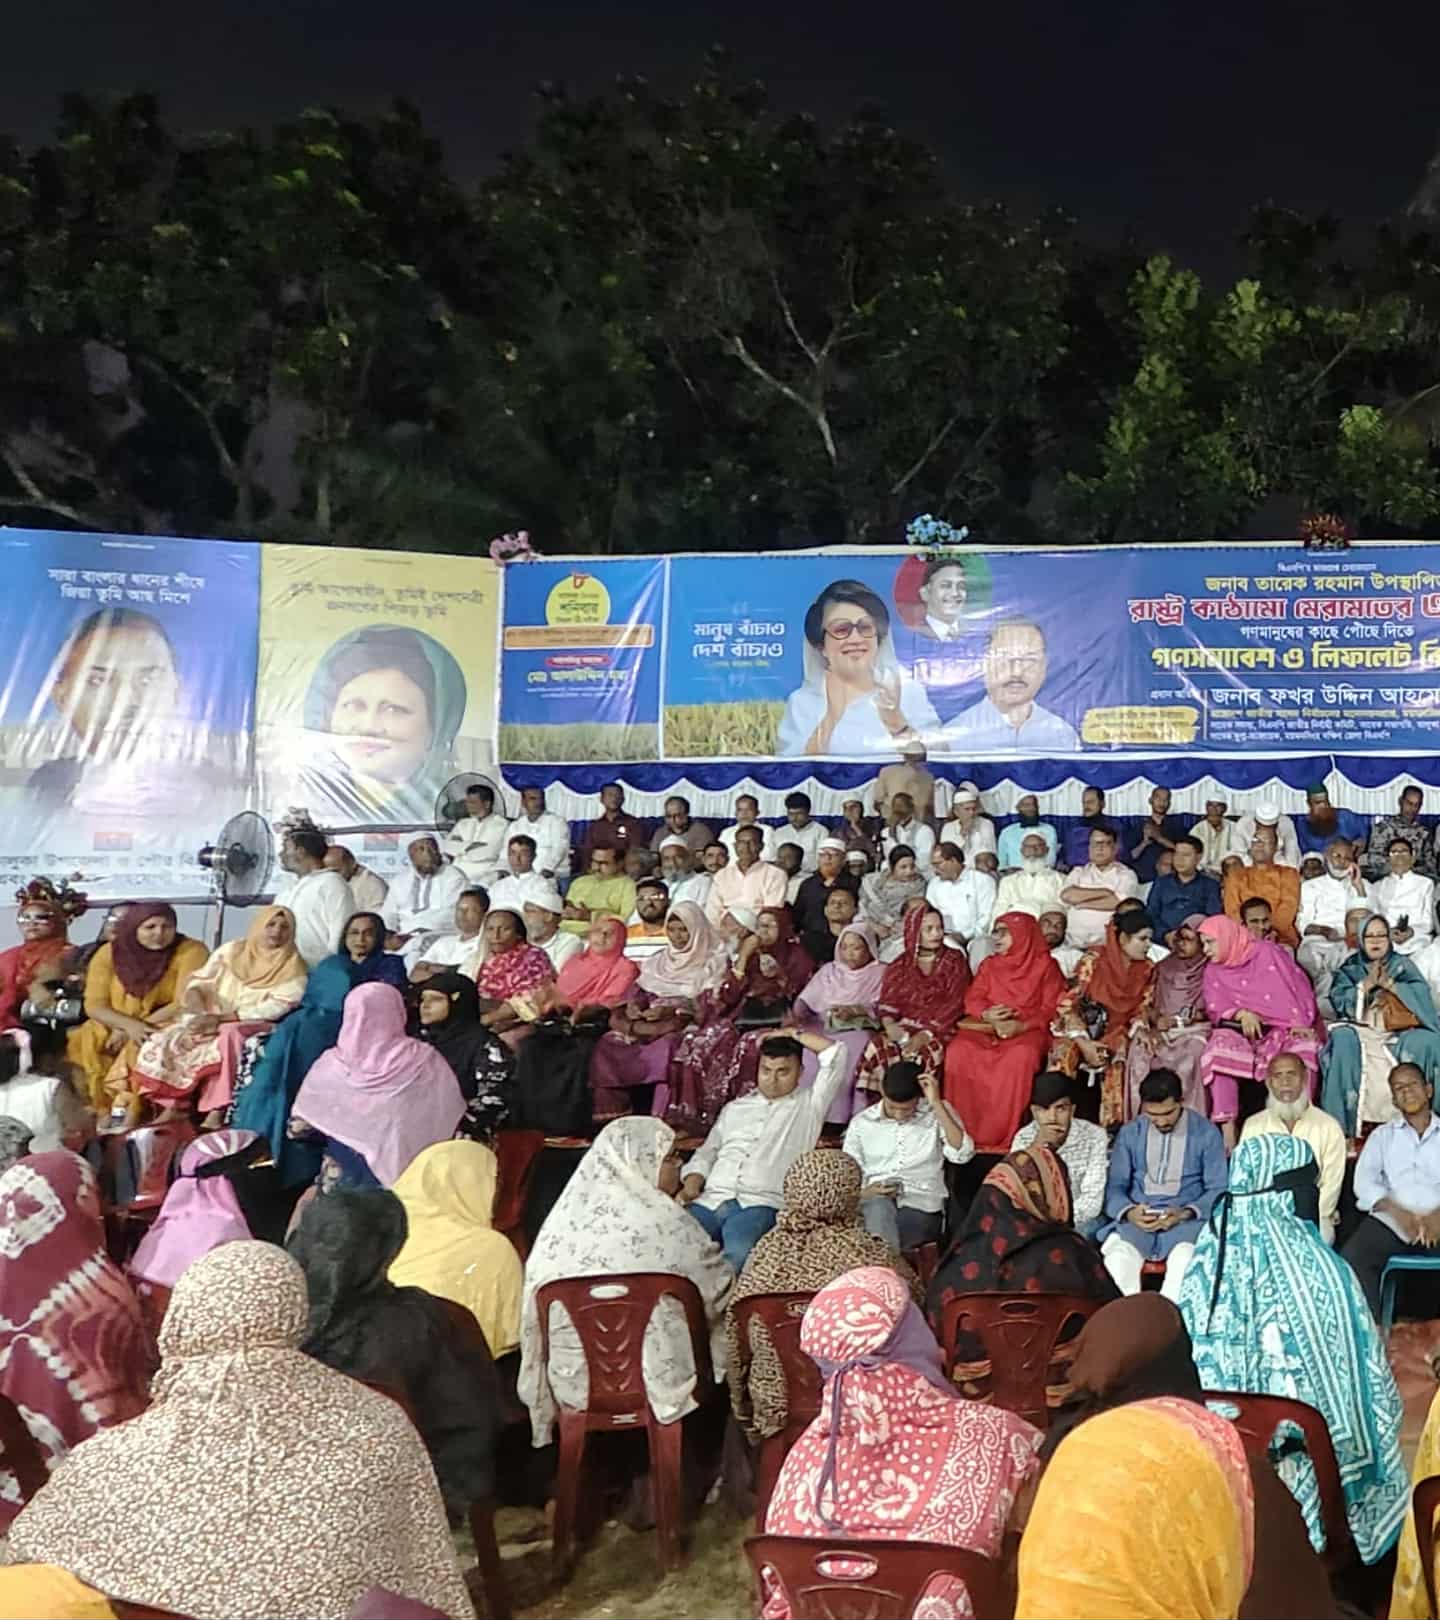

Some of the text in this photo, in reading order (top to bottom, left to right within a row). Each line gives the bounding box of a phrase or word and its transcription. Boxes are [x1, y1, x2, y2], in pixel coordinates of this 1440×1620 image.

[81, 570, 126, 585] বাংলার
[1204, 576, 1249, 592] জনাব
[1255, 576, 1308, 592] তারেক
[1312, 575, 1364, 592] রহমান
[96, 585, 122, 604] তুমি
[1127, 593, 1186, 626] রাষ্ট্র
[1190, 591, 1288, 621] কাঠামো
[1293, 596, 1414, 621] মেরামতের
[693, 619, 785, 641] মানুষ বাঁচাও
[1240, 625, 1304, 641] গণমানুষের
[1308, 624, 1339, 640] কাছে
[1383, 622, 1415, 639] দিতে
[693, 638, 783, 659] দেশ বাঁচাও
[1151, 646, 1277, 670] গণসমাবেশ
[1282, 647, 1305, 669] ও
[1311, 640, 1414, 669] লিফলেট
[1210, 688, 1263, 706] জনাব
[1267, 686, 1315, 705] ফখর
[1320, 683, 1374, 705] উদ্দিন
